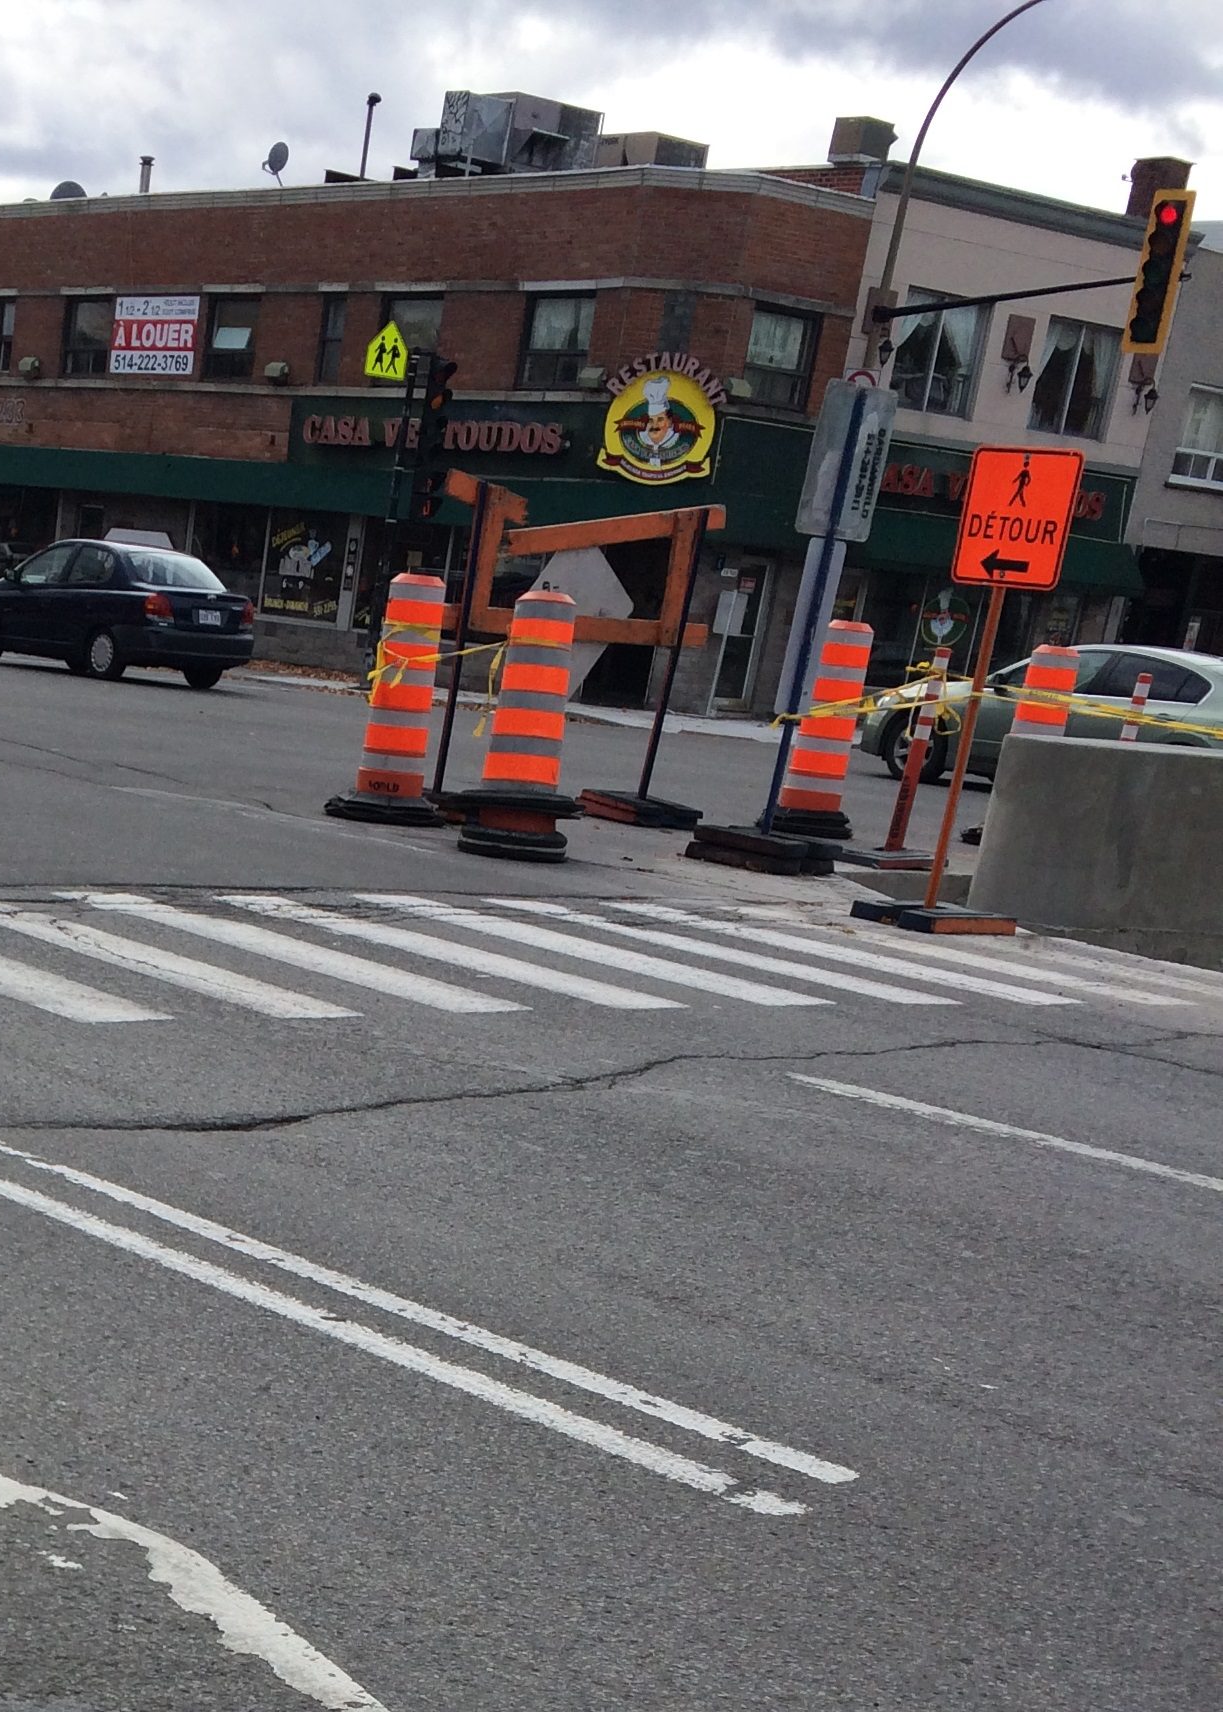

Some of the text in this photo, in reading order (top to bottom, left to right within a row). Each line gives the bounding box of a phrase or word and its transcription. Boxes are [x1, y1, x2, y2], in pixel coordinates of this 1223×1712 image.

[114, 321, 194, 347] À LOUER
[114, 354, 189, 371] 514-222-3769
[606, 352, 727, 406] RESTAURANT
[302, 414, 371, 446] CASA
[880, 464, 935, 498] ASA
[968, 511, 1057, 545] DÉTOUR
